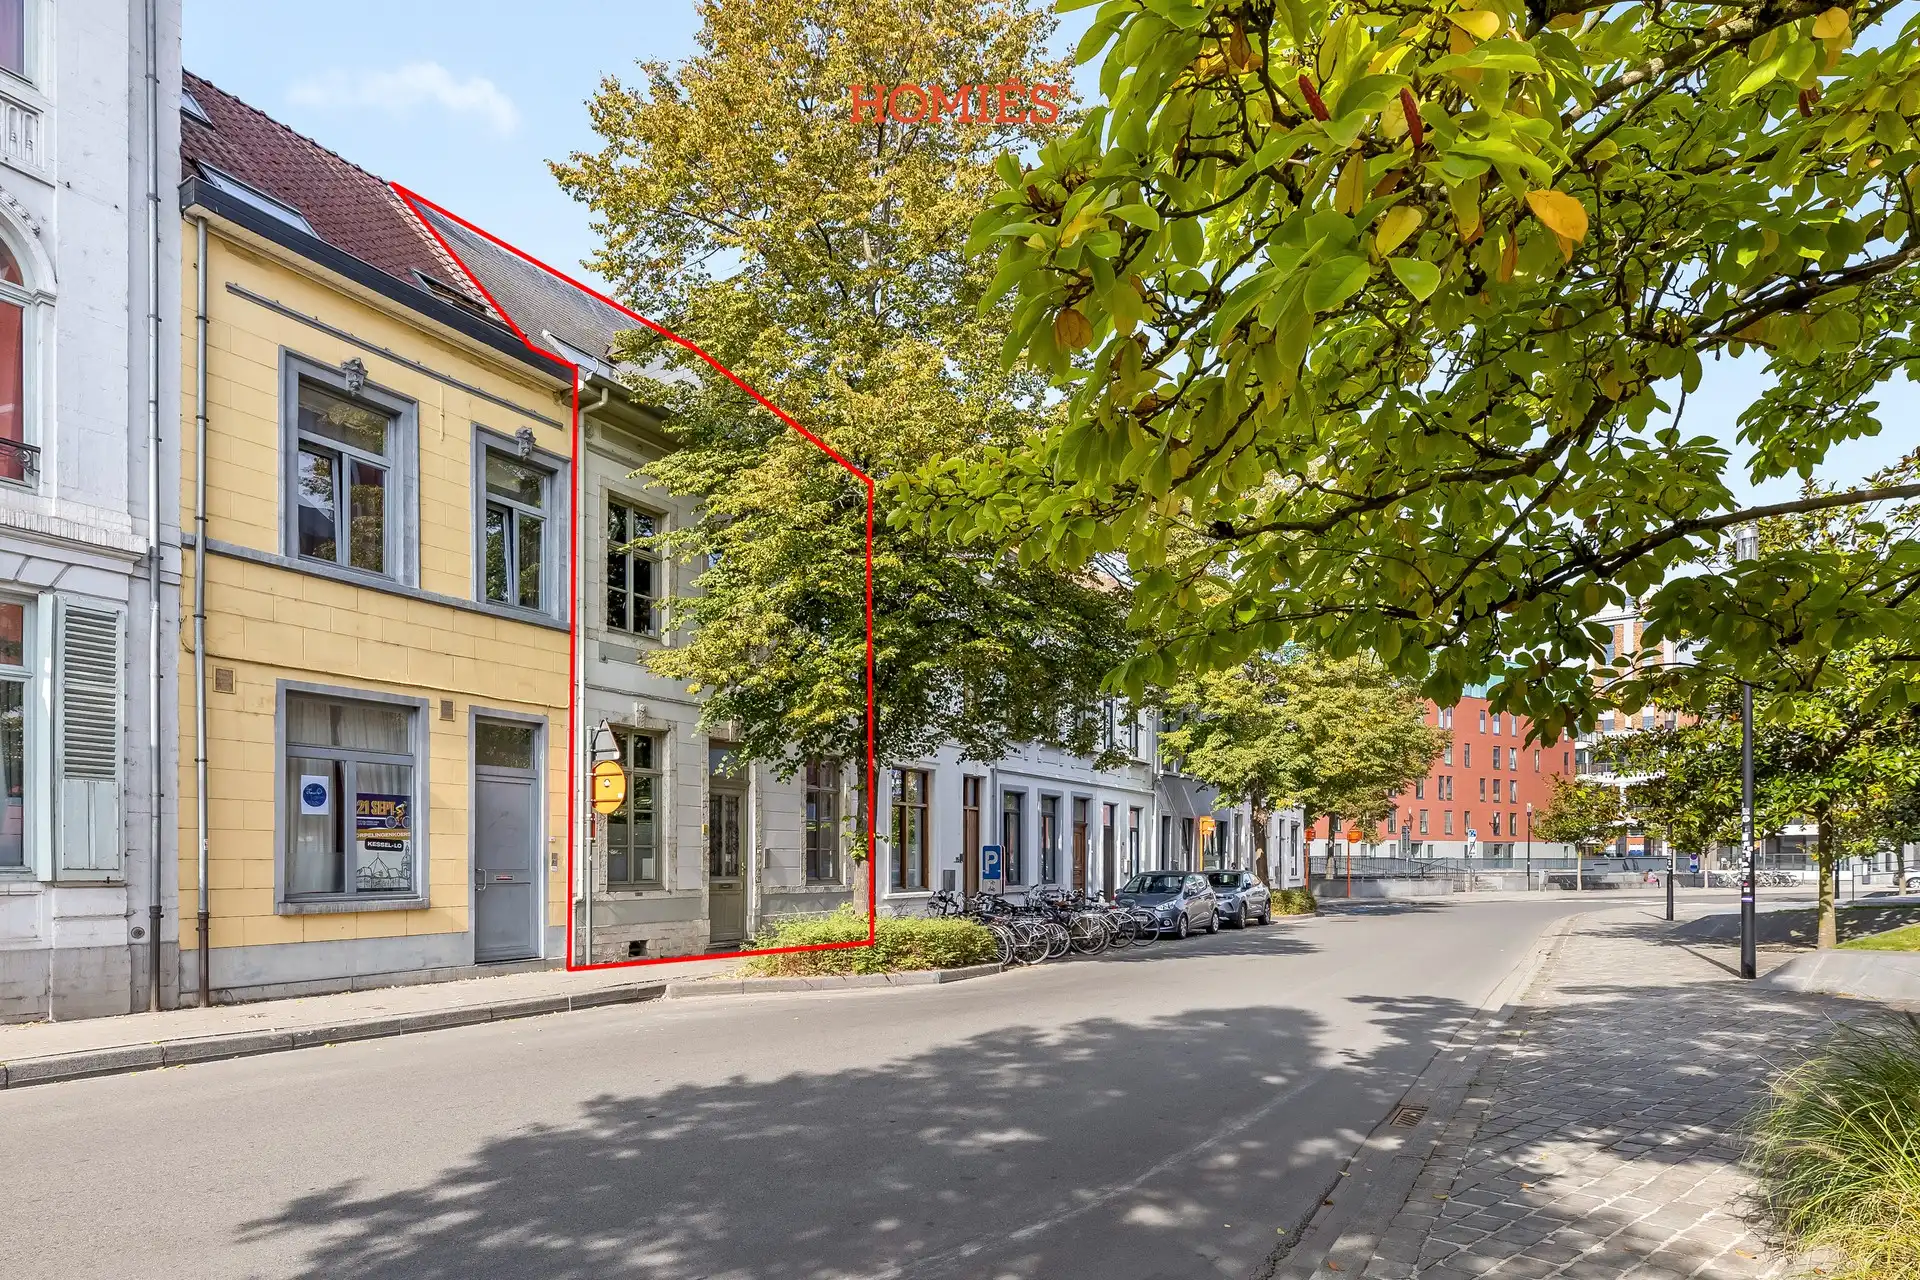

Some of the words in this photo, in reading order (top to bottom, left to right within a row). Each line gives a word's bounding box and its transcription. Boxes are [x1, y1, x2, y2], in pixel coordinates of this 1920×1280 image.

[356, 799, 370, 815] 21
[367, 841, 403, 849] KESSEL-LO
[985, 850, 998, 874] P
